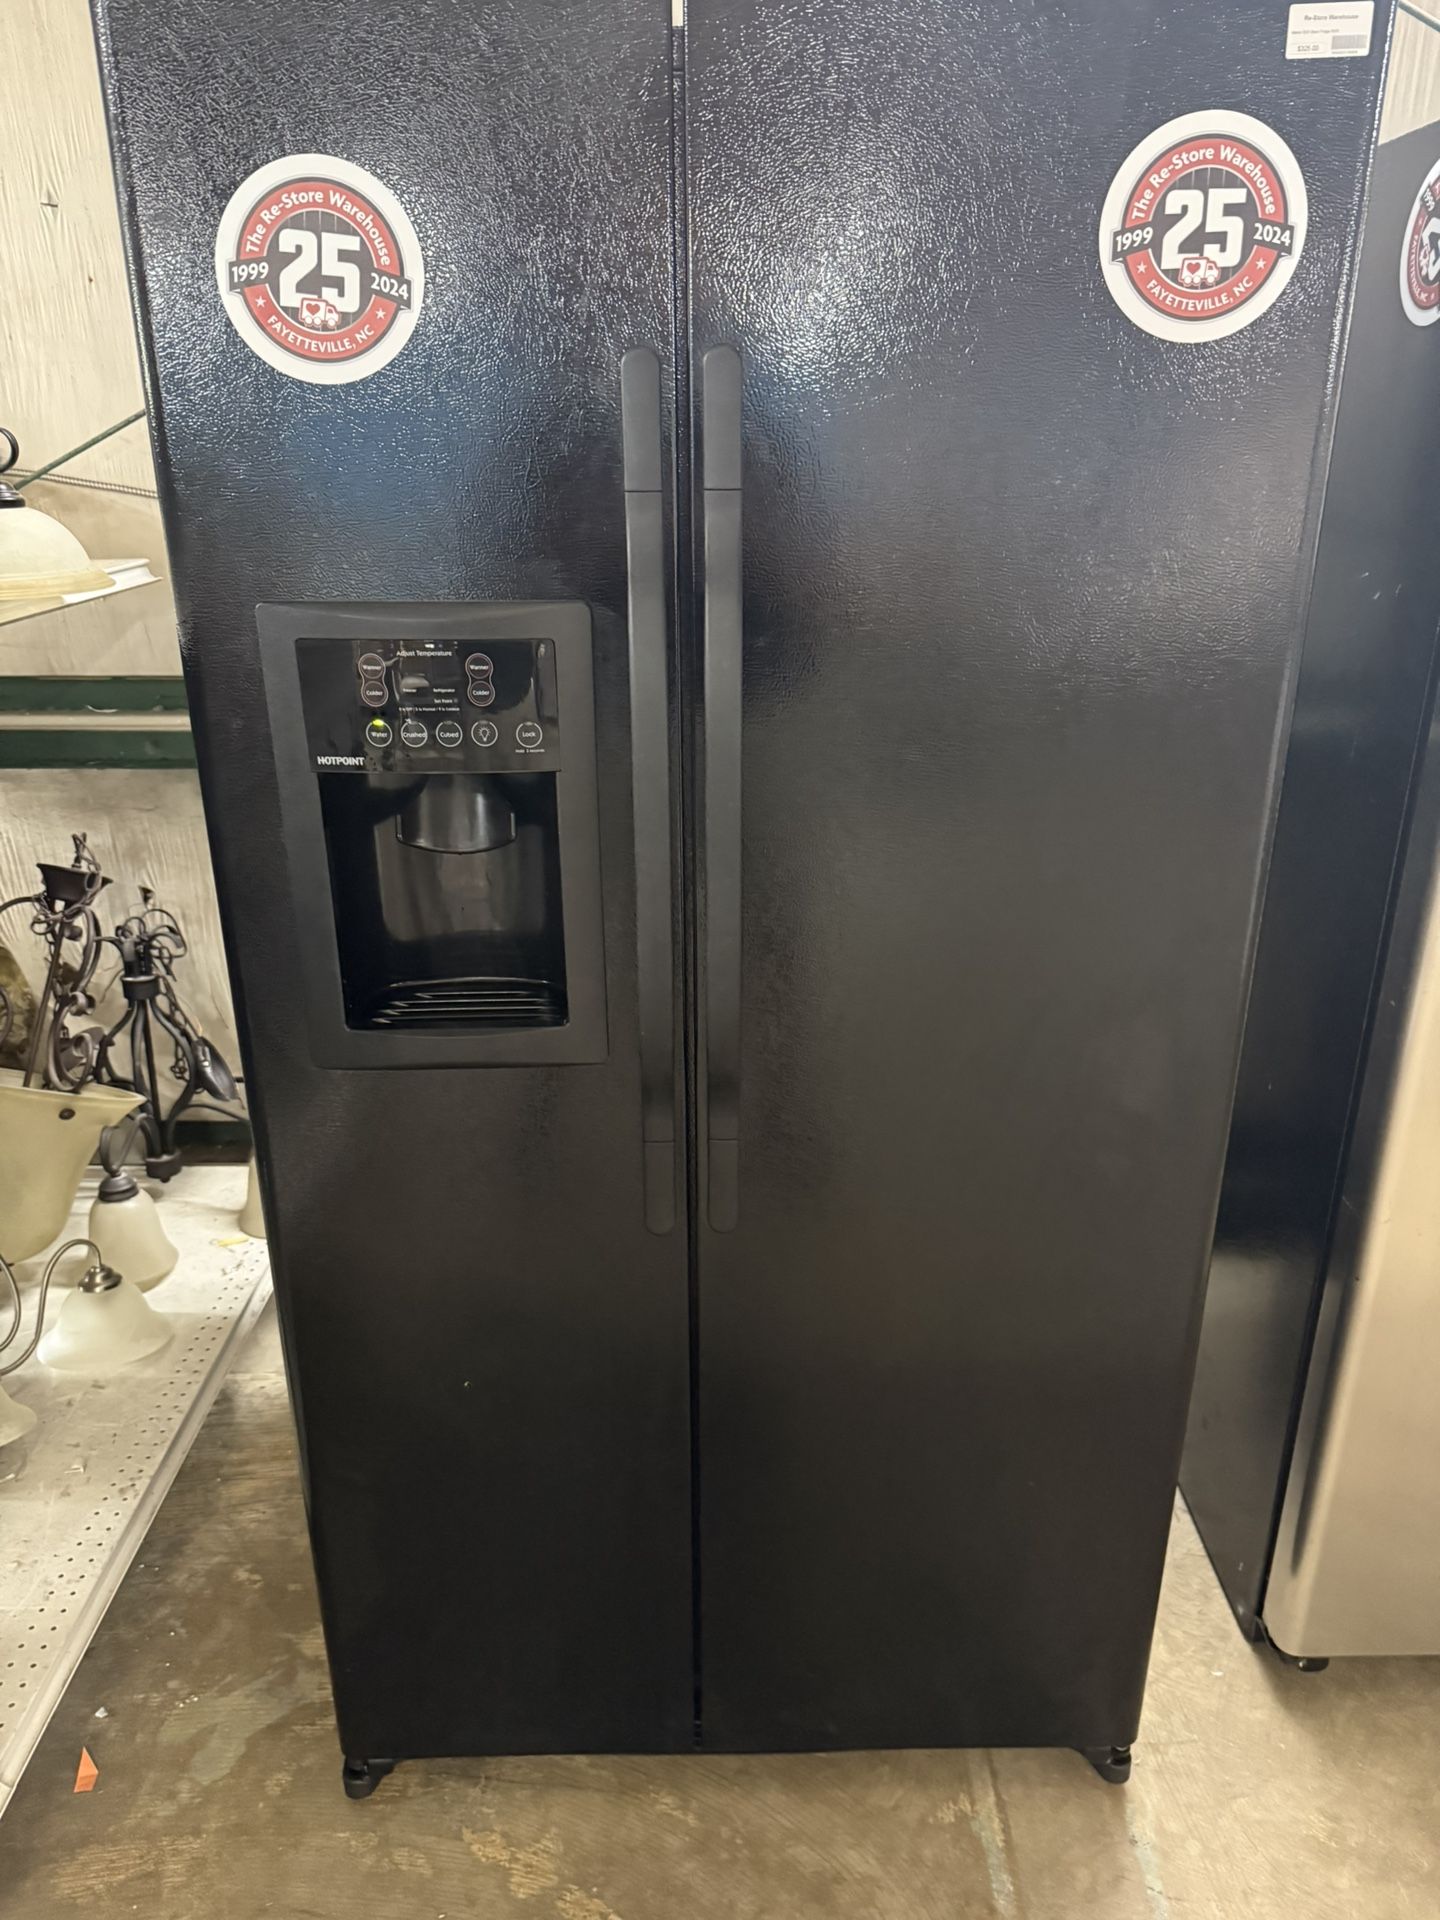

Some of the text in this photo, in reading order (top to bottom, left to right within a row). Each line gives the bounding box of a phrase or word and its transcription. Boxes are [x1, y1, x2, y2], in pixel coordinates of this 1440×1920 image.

[1132, 145, 1275, 220] The Re-Store Warehouse
[246, 189, 390, 266] The Re-Store Warehouse
[1115, 226, 1153, 252] 1999
[1161, 187, 1247, 270] 25
[1253, 222, 1291, 247] 2024
[231, 261, 269, 282] 1999
[278, 228, 361, 313] 25
[370, 273, 409, 300] 2024
[1146, 275, 1253, 311] FAYETTEVILLE, NC
[266, 315, 375, 353] FAYETTEVILLE, NC
[396, 650, 453, 658] Adjust Temperature
[317, 756, 365, 767] HOTPOINT
